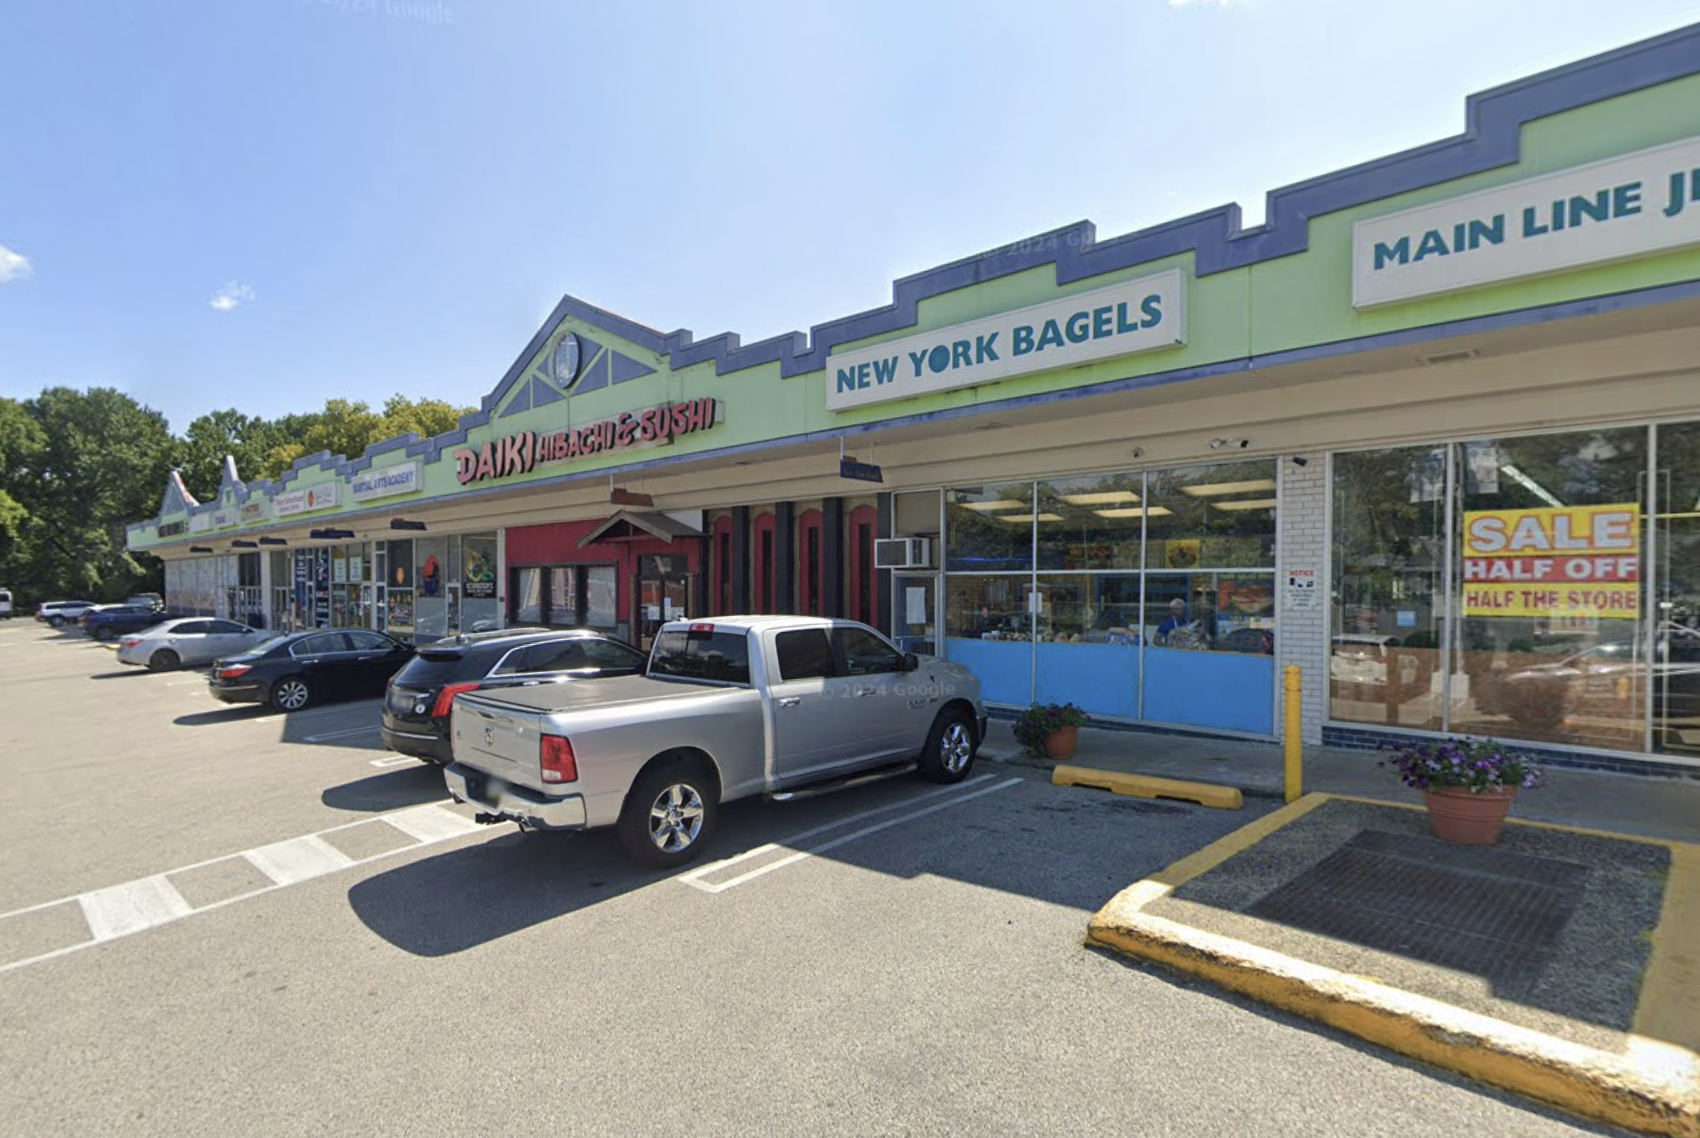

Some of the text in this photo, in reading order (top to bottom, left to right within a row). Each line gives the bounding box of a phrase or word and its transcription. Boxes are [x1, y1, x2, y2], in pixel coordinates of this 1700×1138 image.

[1374, 214, 1505, 270] MAIN
[1523, 181, 1643, 238] LINE
[836, 294, 1162, 393] NEW YORK BAGELS
[453, 396, 716, 485] DAIKI HIBACHI & SUSHI
[1469, 511, 1633, 552] SALE
[1464, 557, 1638, 580] HALF OFF
[1467, 590, 1637, 609] HALF THE STORE
